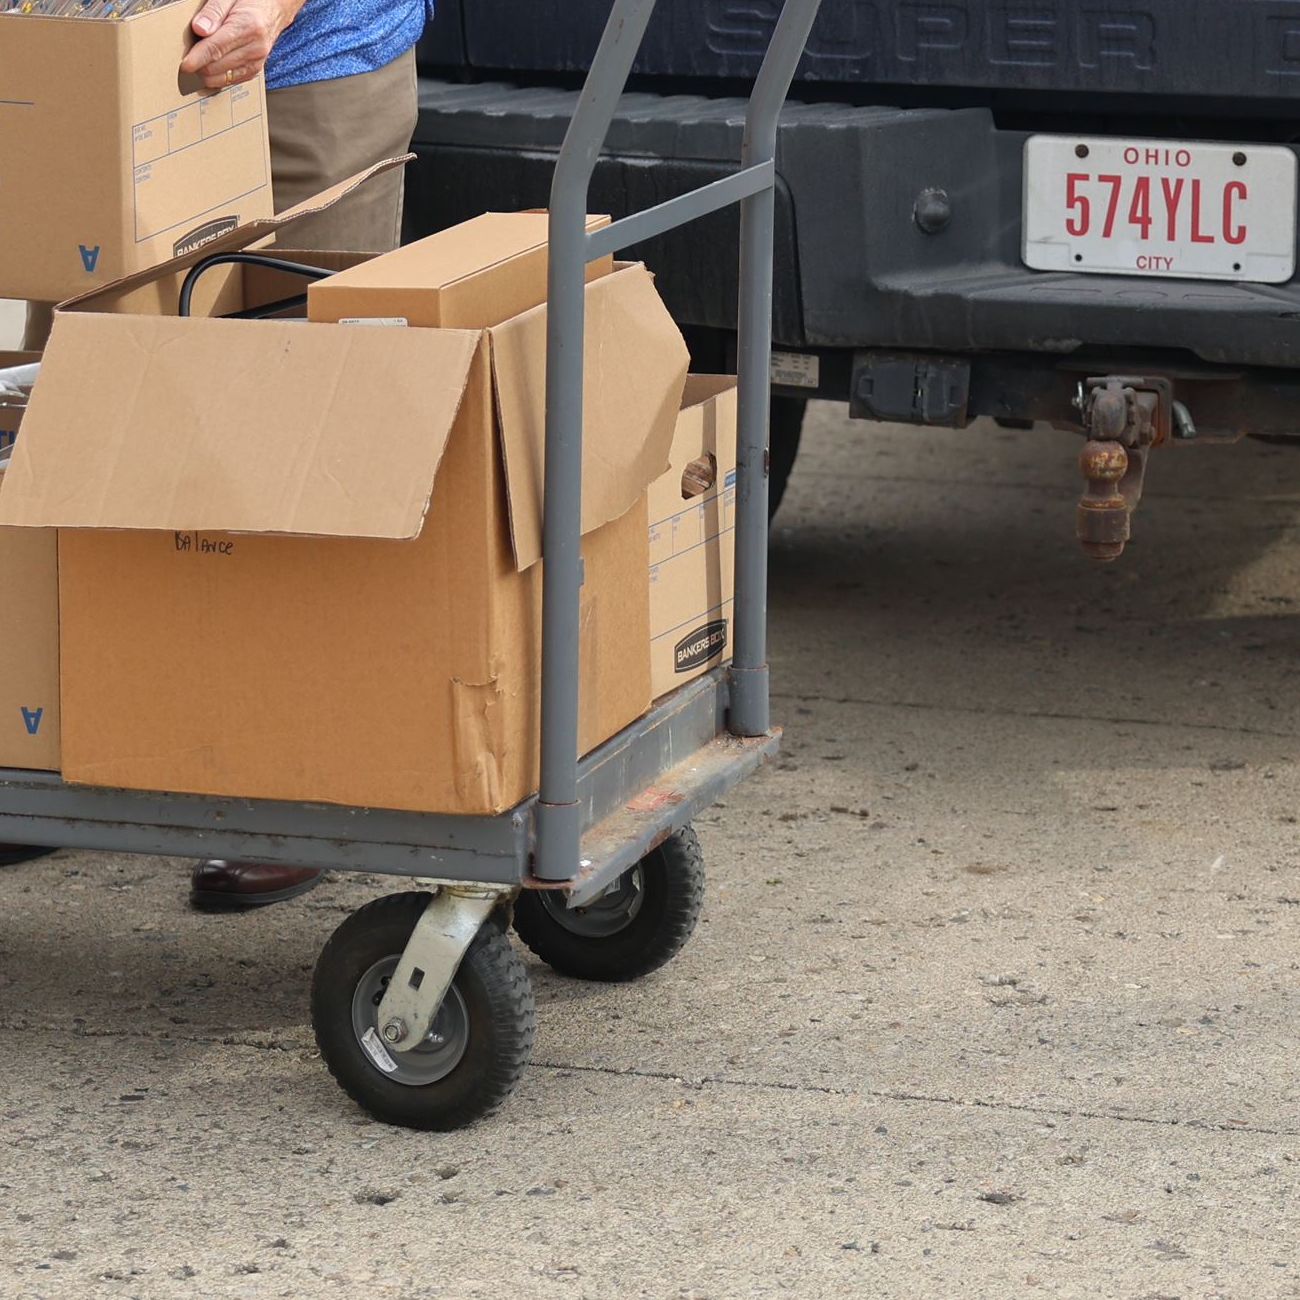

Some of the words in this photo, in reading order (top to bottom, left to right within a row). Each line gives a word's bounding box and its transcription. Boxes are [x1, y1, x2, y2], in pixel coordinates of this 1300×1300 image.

[1123, 147, 1192, 167] OHIO
[1066, 173, 1247, 244] 574YLC
[78, 245, 100, 272] A
[1136, 255, 1174, 270] CITY
[677, 636, 710, 663] BANKERS
[710, 628, 725, 645] BOX
[20, 706, 43, 734] A
